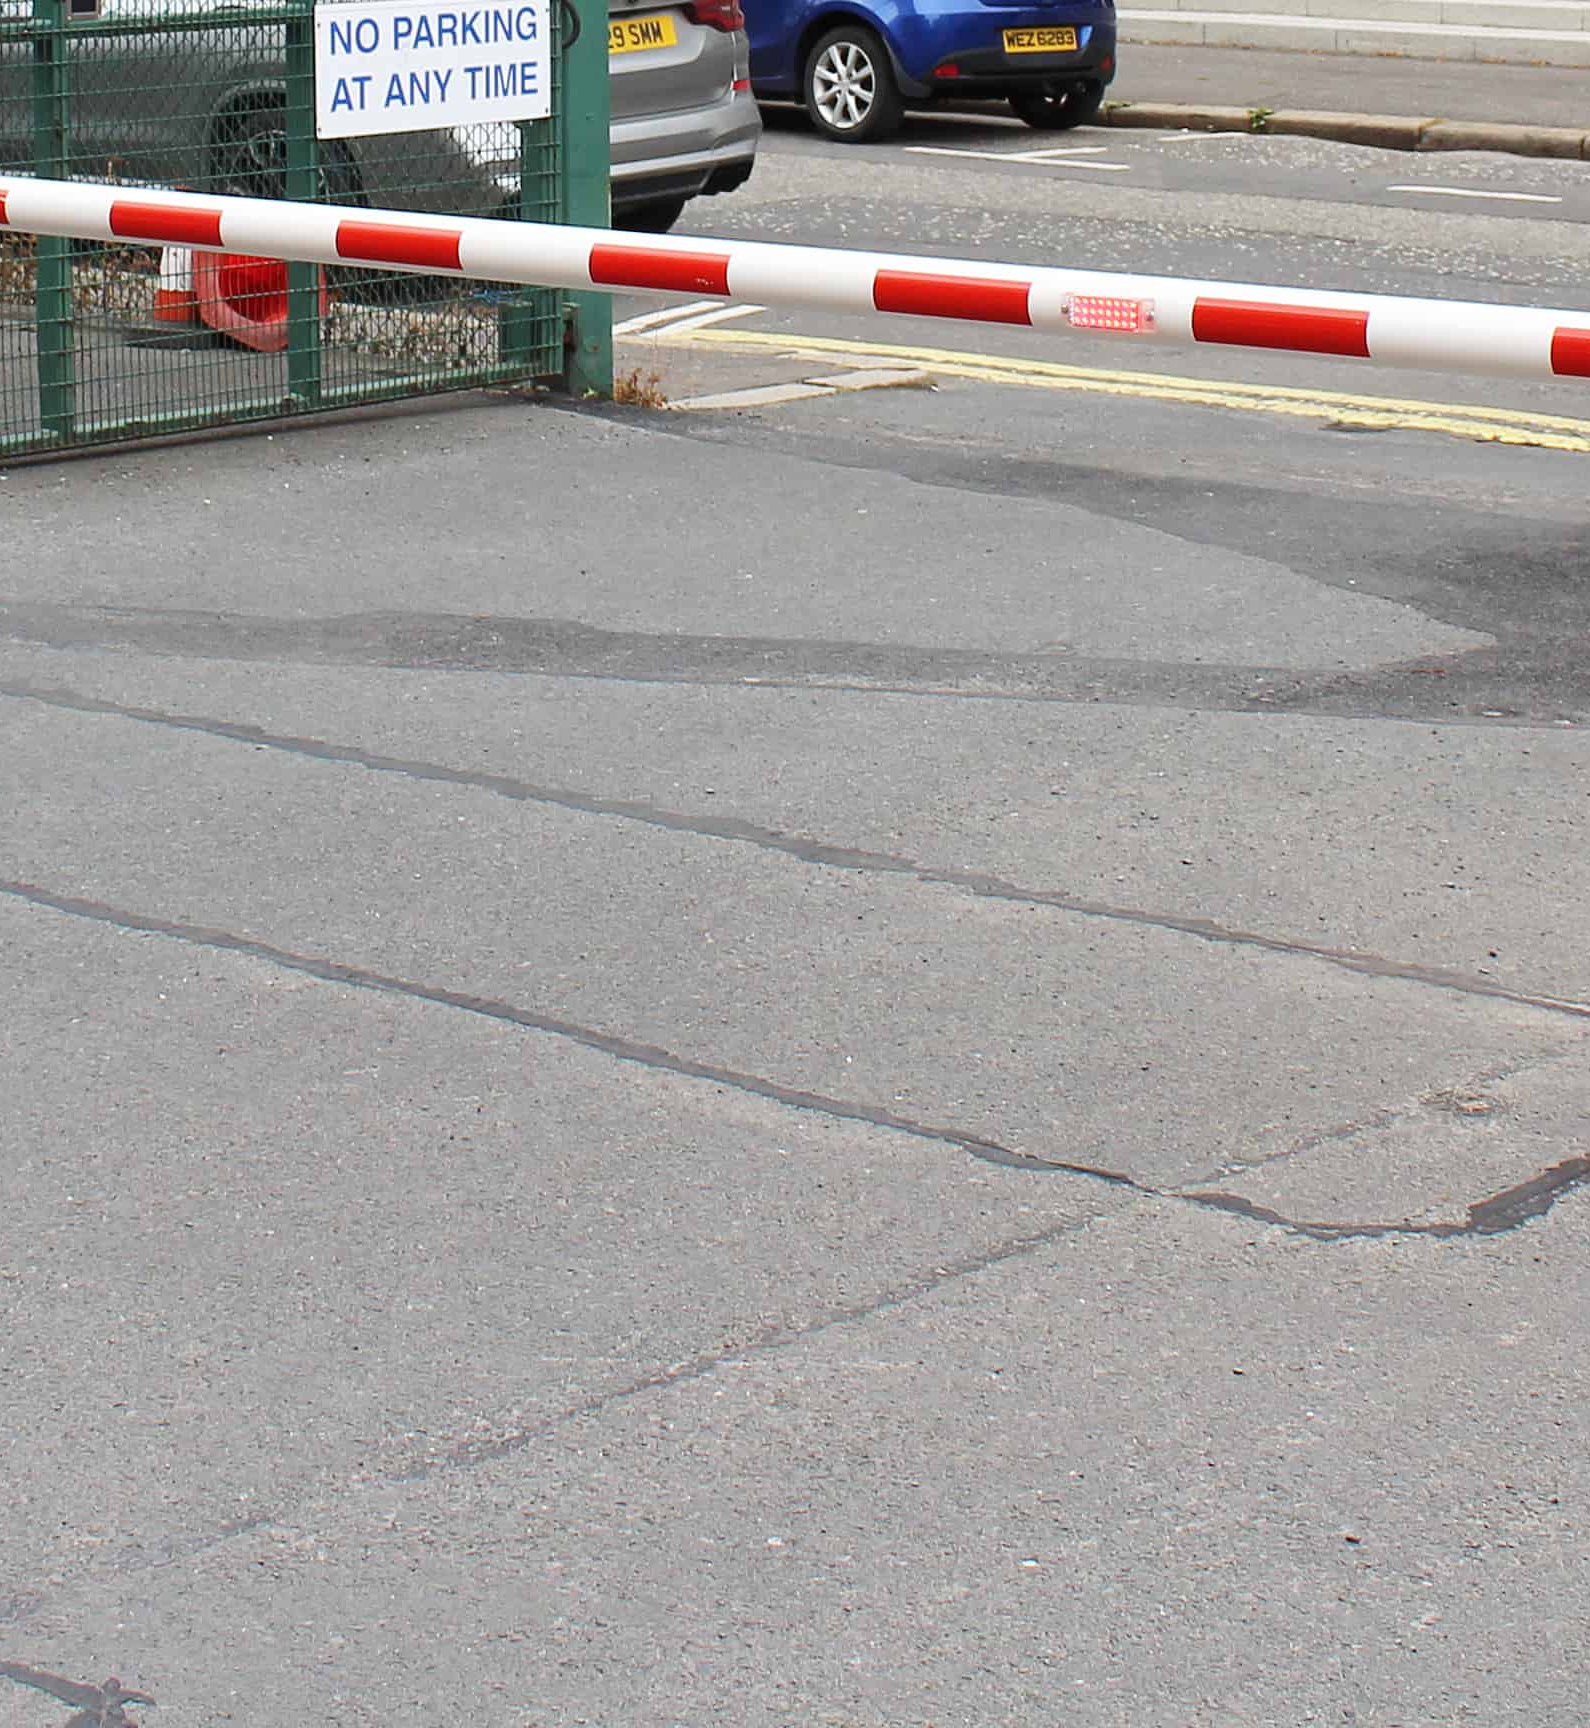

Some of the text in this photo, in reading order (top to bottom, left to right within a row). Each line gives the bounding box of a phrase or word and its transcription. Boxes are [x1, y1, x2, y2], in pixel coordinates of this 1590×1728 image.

[329, 6, 538, 56] NO PARKING
[627, 21, 664, 46] SMM
[329, 61, 540, 113] AT ANY TIME
